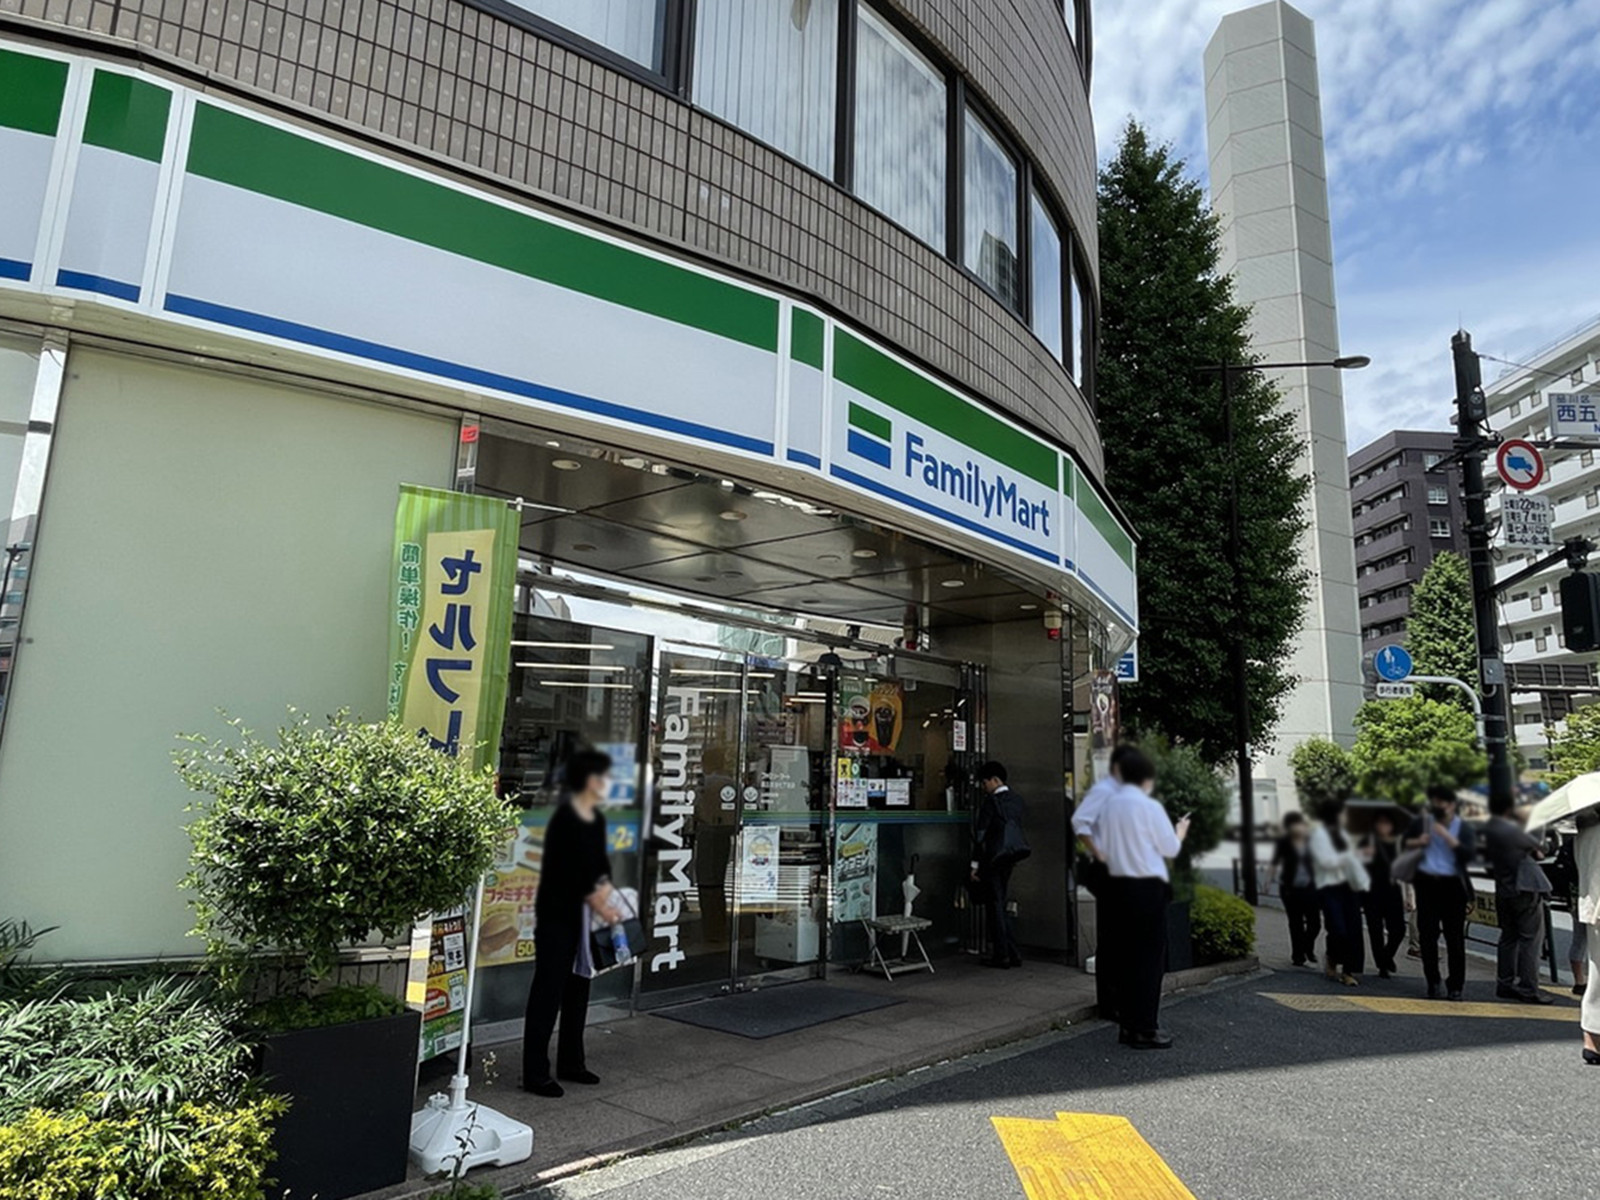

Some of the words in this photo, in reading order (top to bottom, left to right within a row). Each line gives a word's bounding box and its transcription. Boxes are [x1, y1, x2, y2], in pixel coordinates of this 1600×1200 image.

[1557, 404, 1598, 422] 西五
[905, 431, 1050, 536] FamilyMart
[652, 686, 700, 972] FamilyMart
